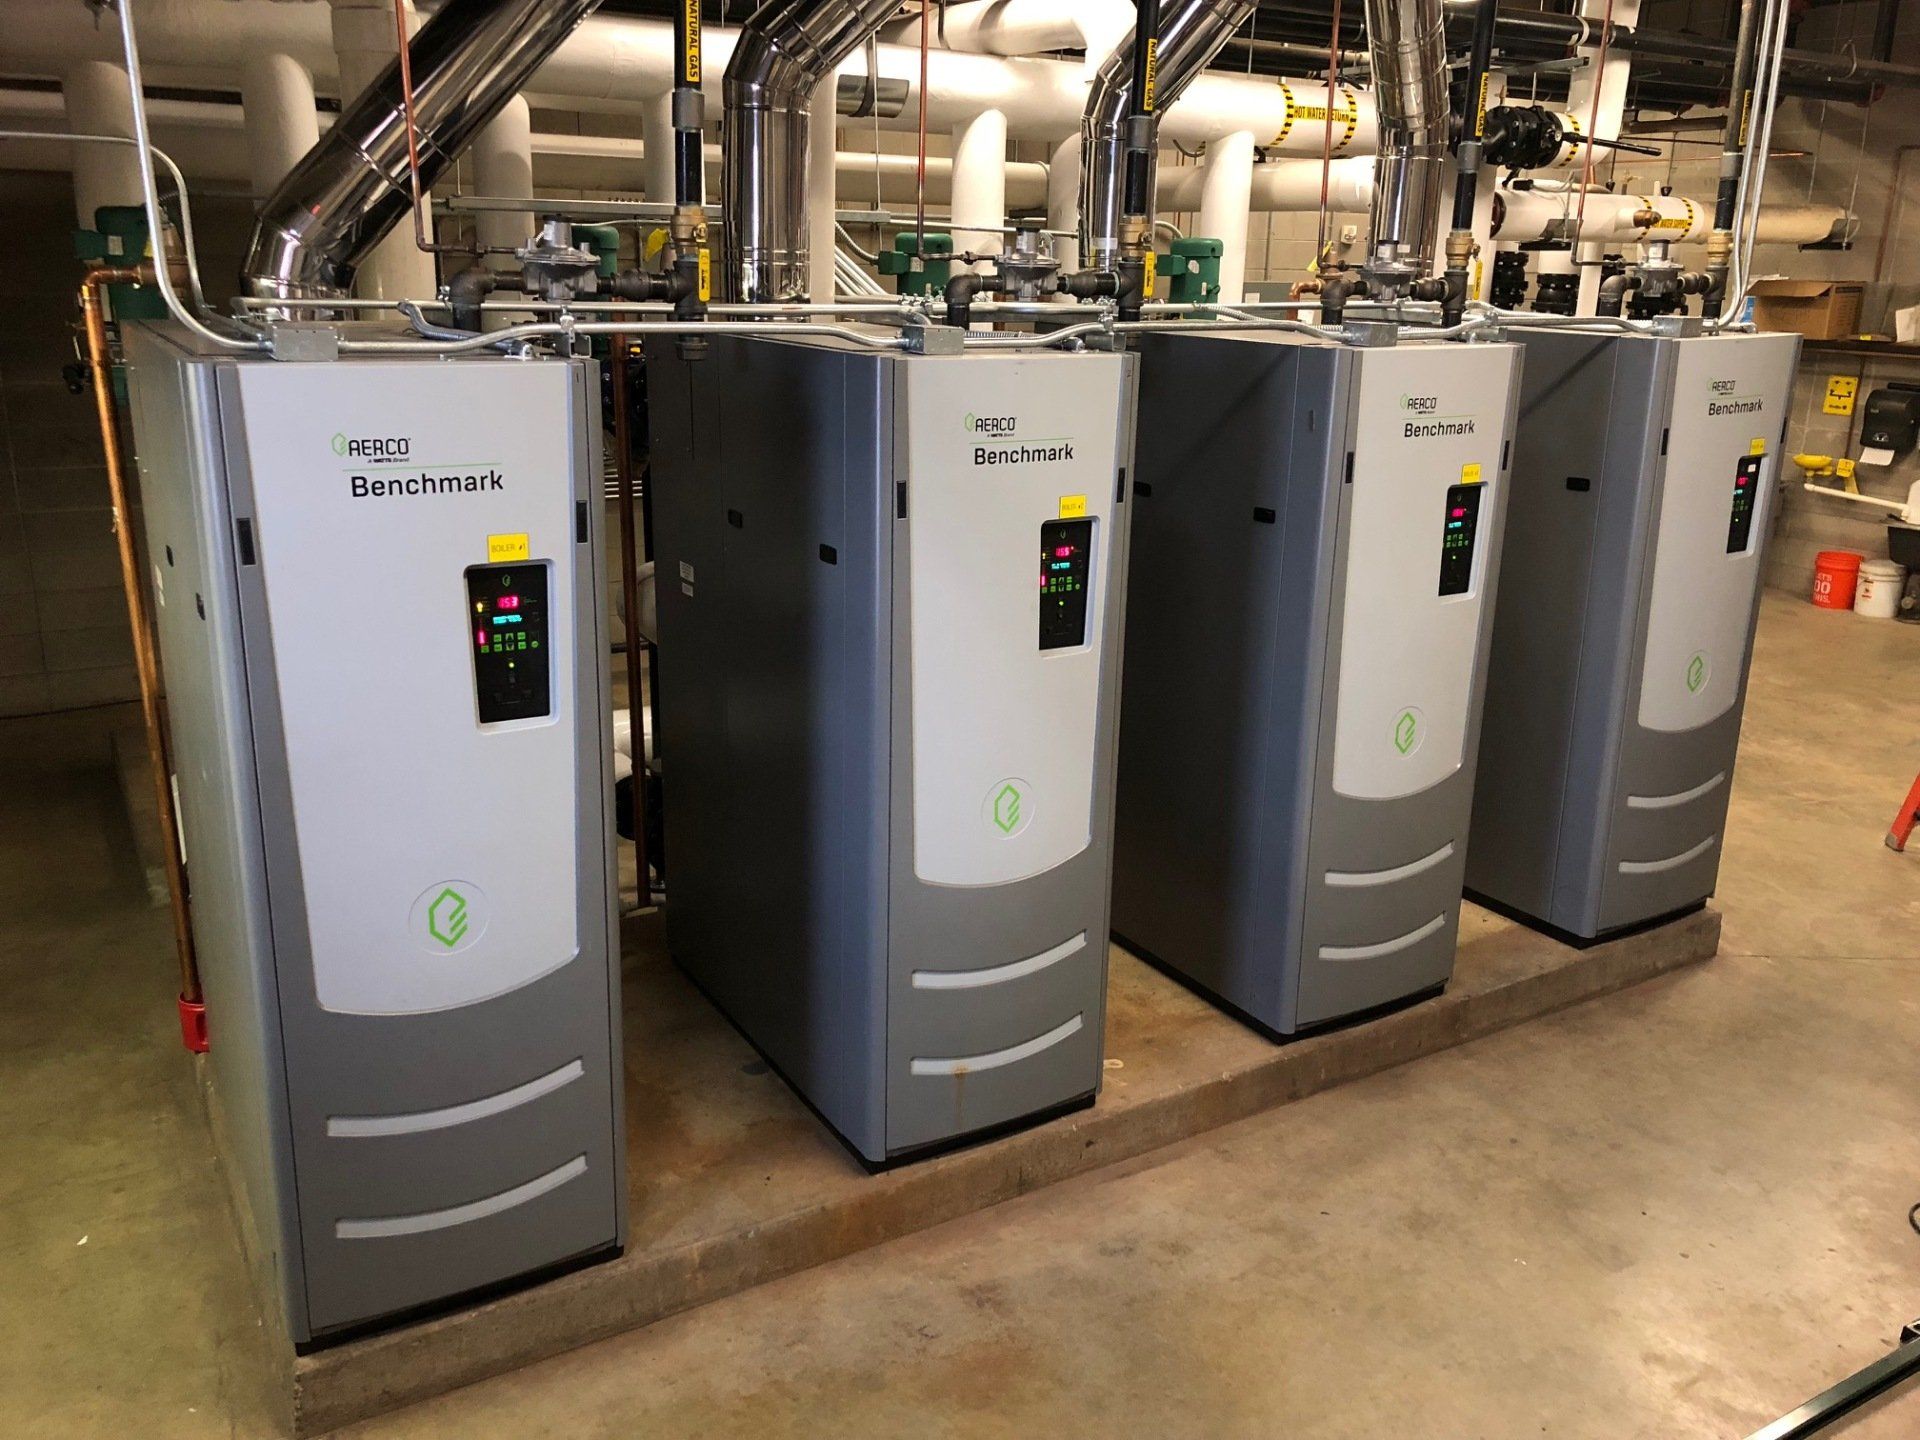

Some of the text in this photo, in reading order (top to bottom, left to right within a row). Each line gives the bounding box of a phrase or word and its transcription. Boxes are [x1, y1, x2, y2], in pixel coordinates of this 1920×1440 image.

[688, 0, 699, 78] NATURAL GAS
[1145, 41, 1157, 108] NATURAL GAS
[1480, 75, 1489, 113] NATURAL
[1294, 105, 1350, 122] HOT WATER ETURN
[1711, 380, 1736, 392] AERCO
[1407, 397, 1437, 410] AERCO
[1708, 399, 1763, 416] Benchmark
[975, 417, 1016, 432] AERCO
[1404, 420, 1475, 438] Benchmark
[348, 438, 410, 457] AERCO
[974, 443, 1073, 466] Benchmark
[351, 470, 504, 497] Benchmark
